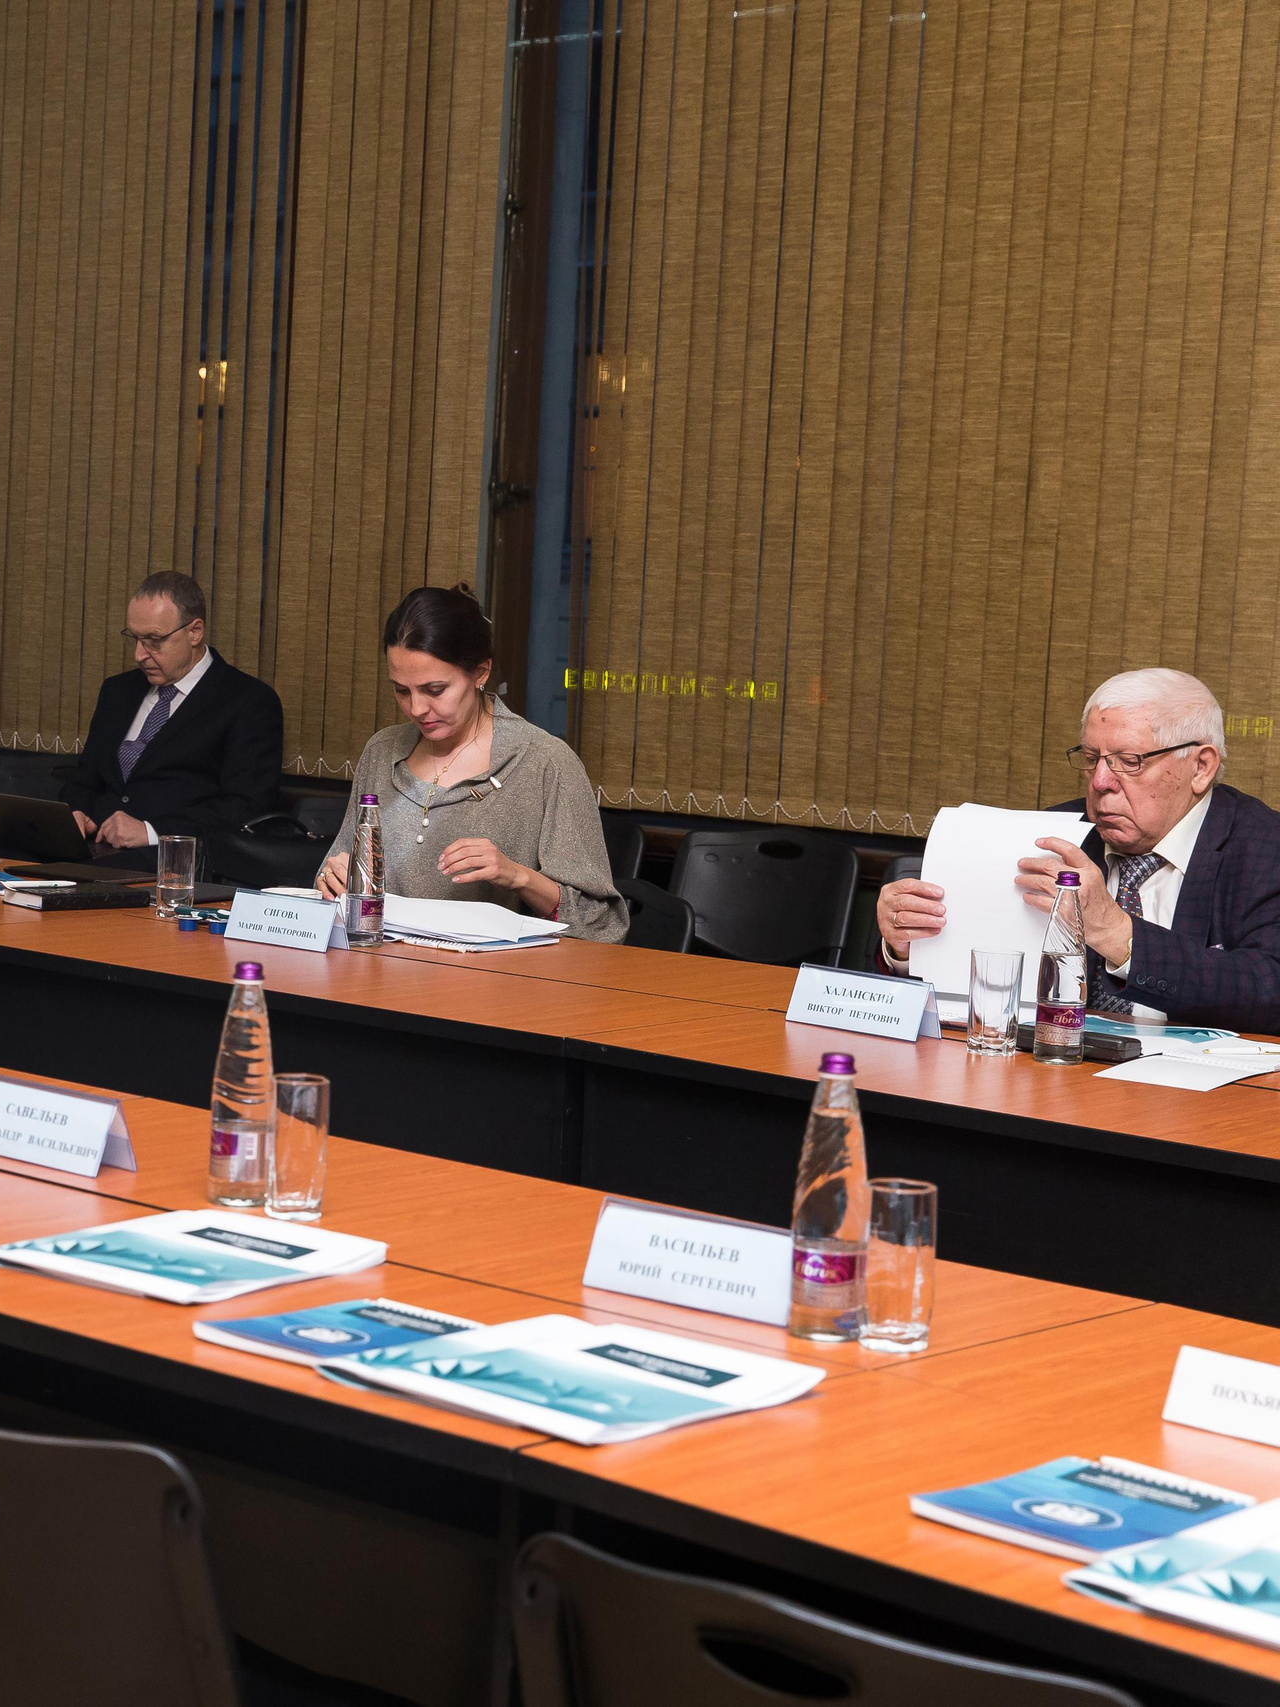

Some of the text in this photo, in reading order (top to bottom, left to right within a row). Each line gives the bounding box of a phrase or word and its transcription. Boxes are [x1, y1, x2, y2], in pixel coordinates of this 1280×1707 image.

[263, 907, 299, 921] СИГОВА
[238, 921, 317, 940] МАРИЯ ВИКТОРОВНА
[823, 984, 895, 1005] ХАЛАНСКИЙ
[807, 1002, 901, 1026] ВИКТОР ПЕТРОВИЧ
[1053, 1015, 1081, 1024] Elbrus
[5, 1102, 69, 1127] САВЕЛЬЕВ
[27, 1134, 99, 1161] ВАСИЛЬЕВИЧ
[648, 1233, 741, 1264] ВАСИЛЬЕВ
[618, 1260, 757, 1300] ЮРИЙ СЕРГЕЕВИЧ
